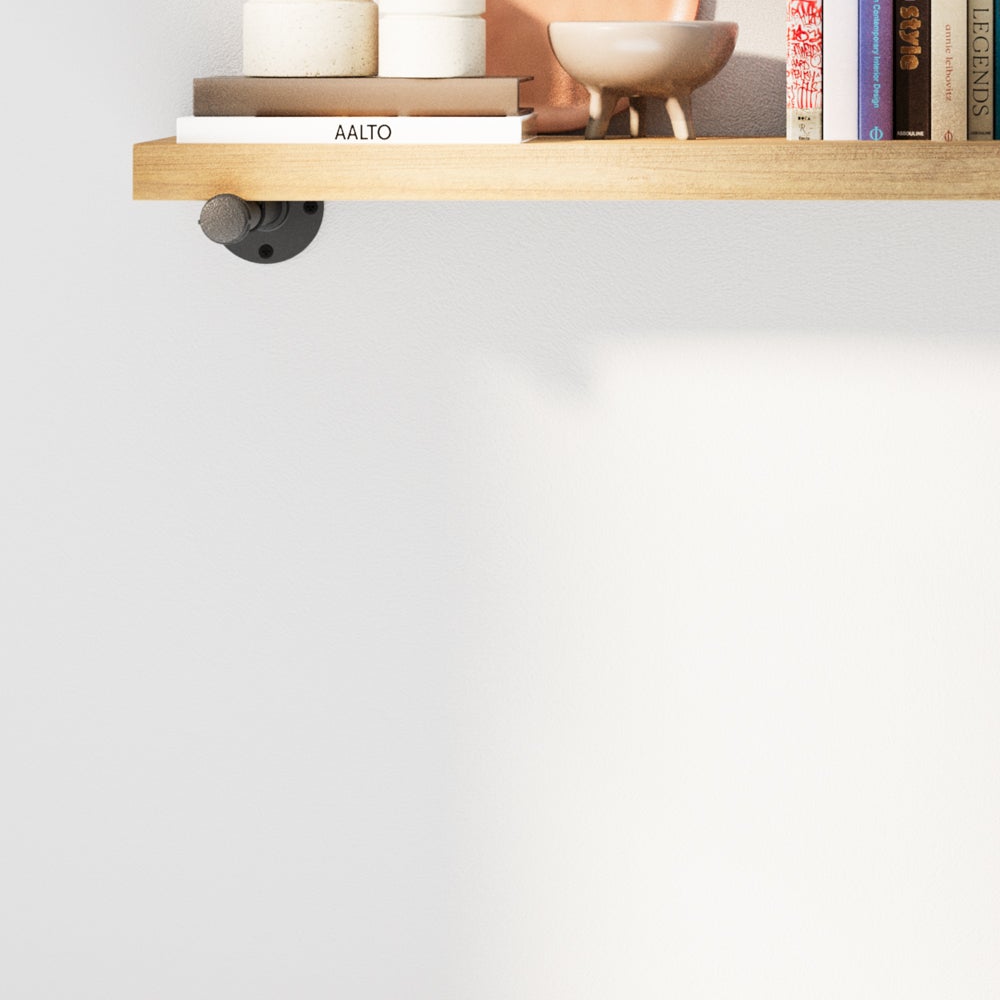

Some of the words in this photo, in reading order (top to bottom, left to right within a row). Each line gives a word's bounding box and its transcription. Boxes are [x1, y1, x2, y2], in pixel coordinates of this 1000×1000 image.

[872, 4, 881, 54] Contemporary
[899, 6, 922, 70] style
[873, 56, 881, 82] Interior
[945, 56, 953, 101] leibovitz
[972, 8, 990, 117] LEGENDS
[872, 83, 881, 108] Design
[335, 124, 392, 140] AALTO
